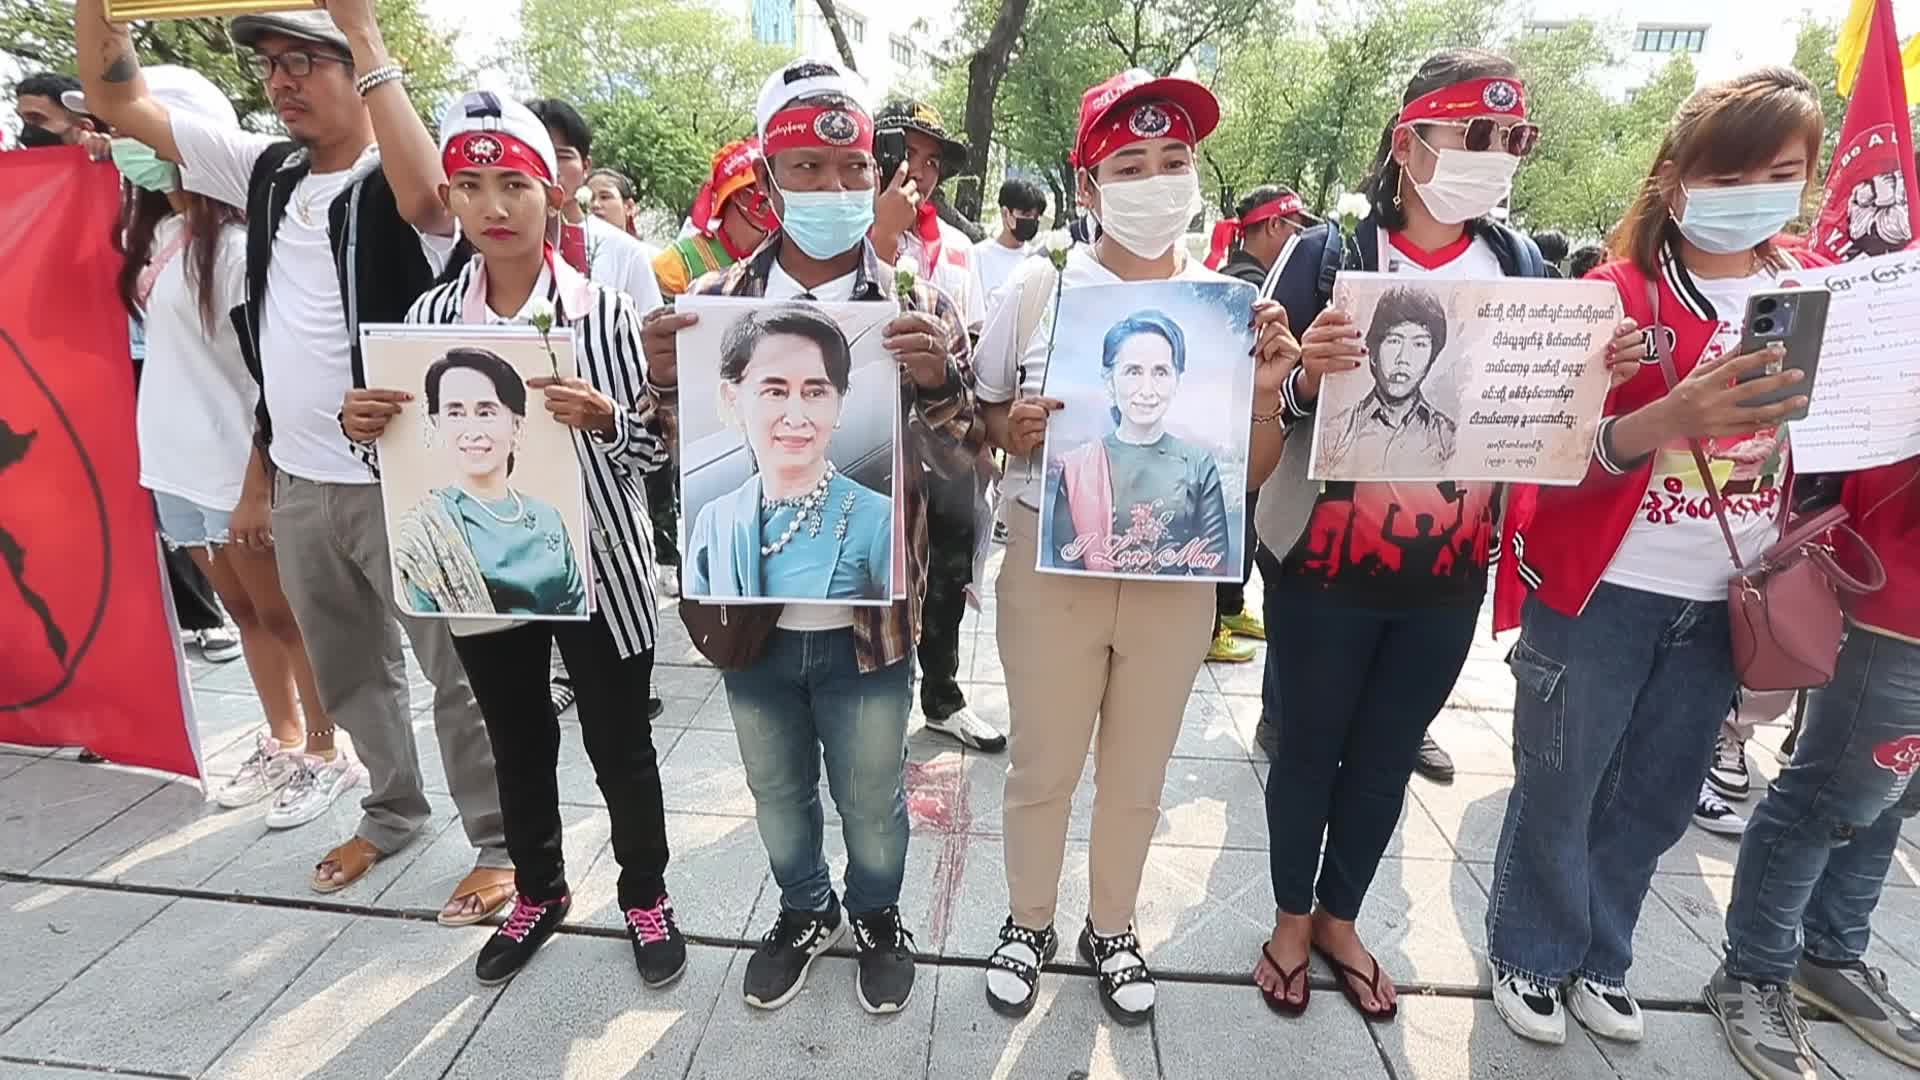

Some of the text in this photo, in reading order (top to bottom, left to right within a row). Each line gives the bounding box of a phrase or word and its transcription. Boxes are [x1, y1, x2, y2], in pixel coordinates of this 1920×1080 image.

[1868, 133, 1884, 148] A
[1061, 533, 1098, 562] I
[1090, 534, 1154, 568] Love
